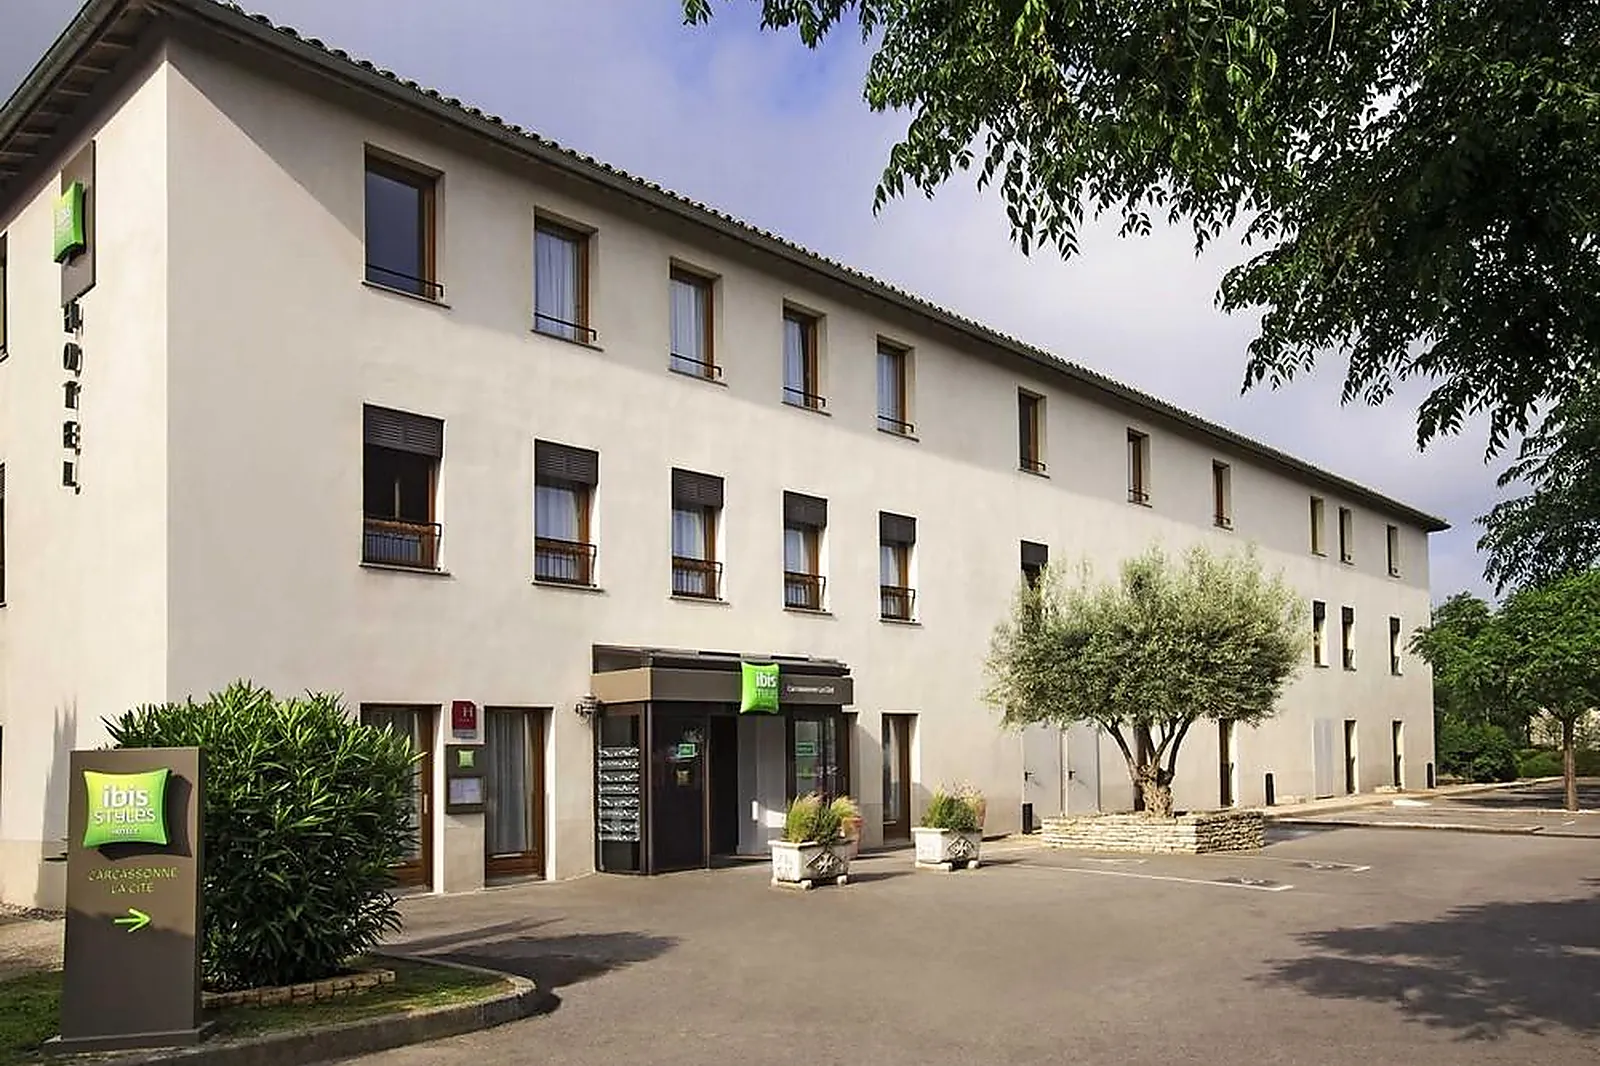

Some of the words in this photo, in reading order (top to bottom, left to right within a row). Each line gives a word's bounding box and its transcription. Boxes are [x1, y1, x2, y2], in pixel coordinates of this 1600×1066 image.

[63, 301, 81, 487] HOTEL
[756, 672, 776, 687] ibis
[103, 784, 148, 808] ibis
[89, 867, 179, 881] CARCASSONNE
[111, 884, 126, 894] LA
